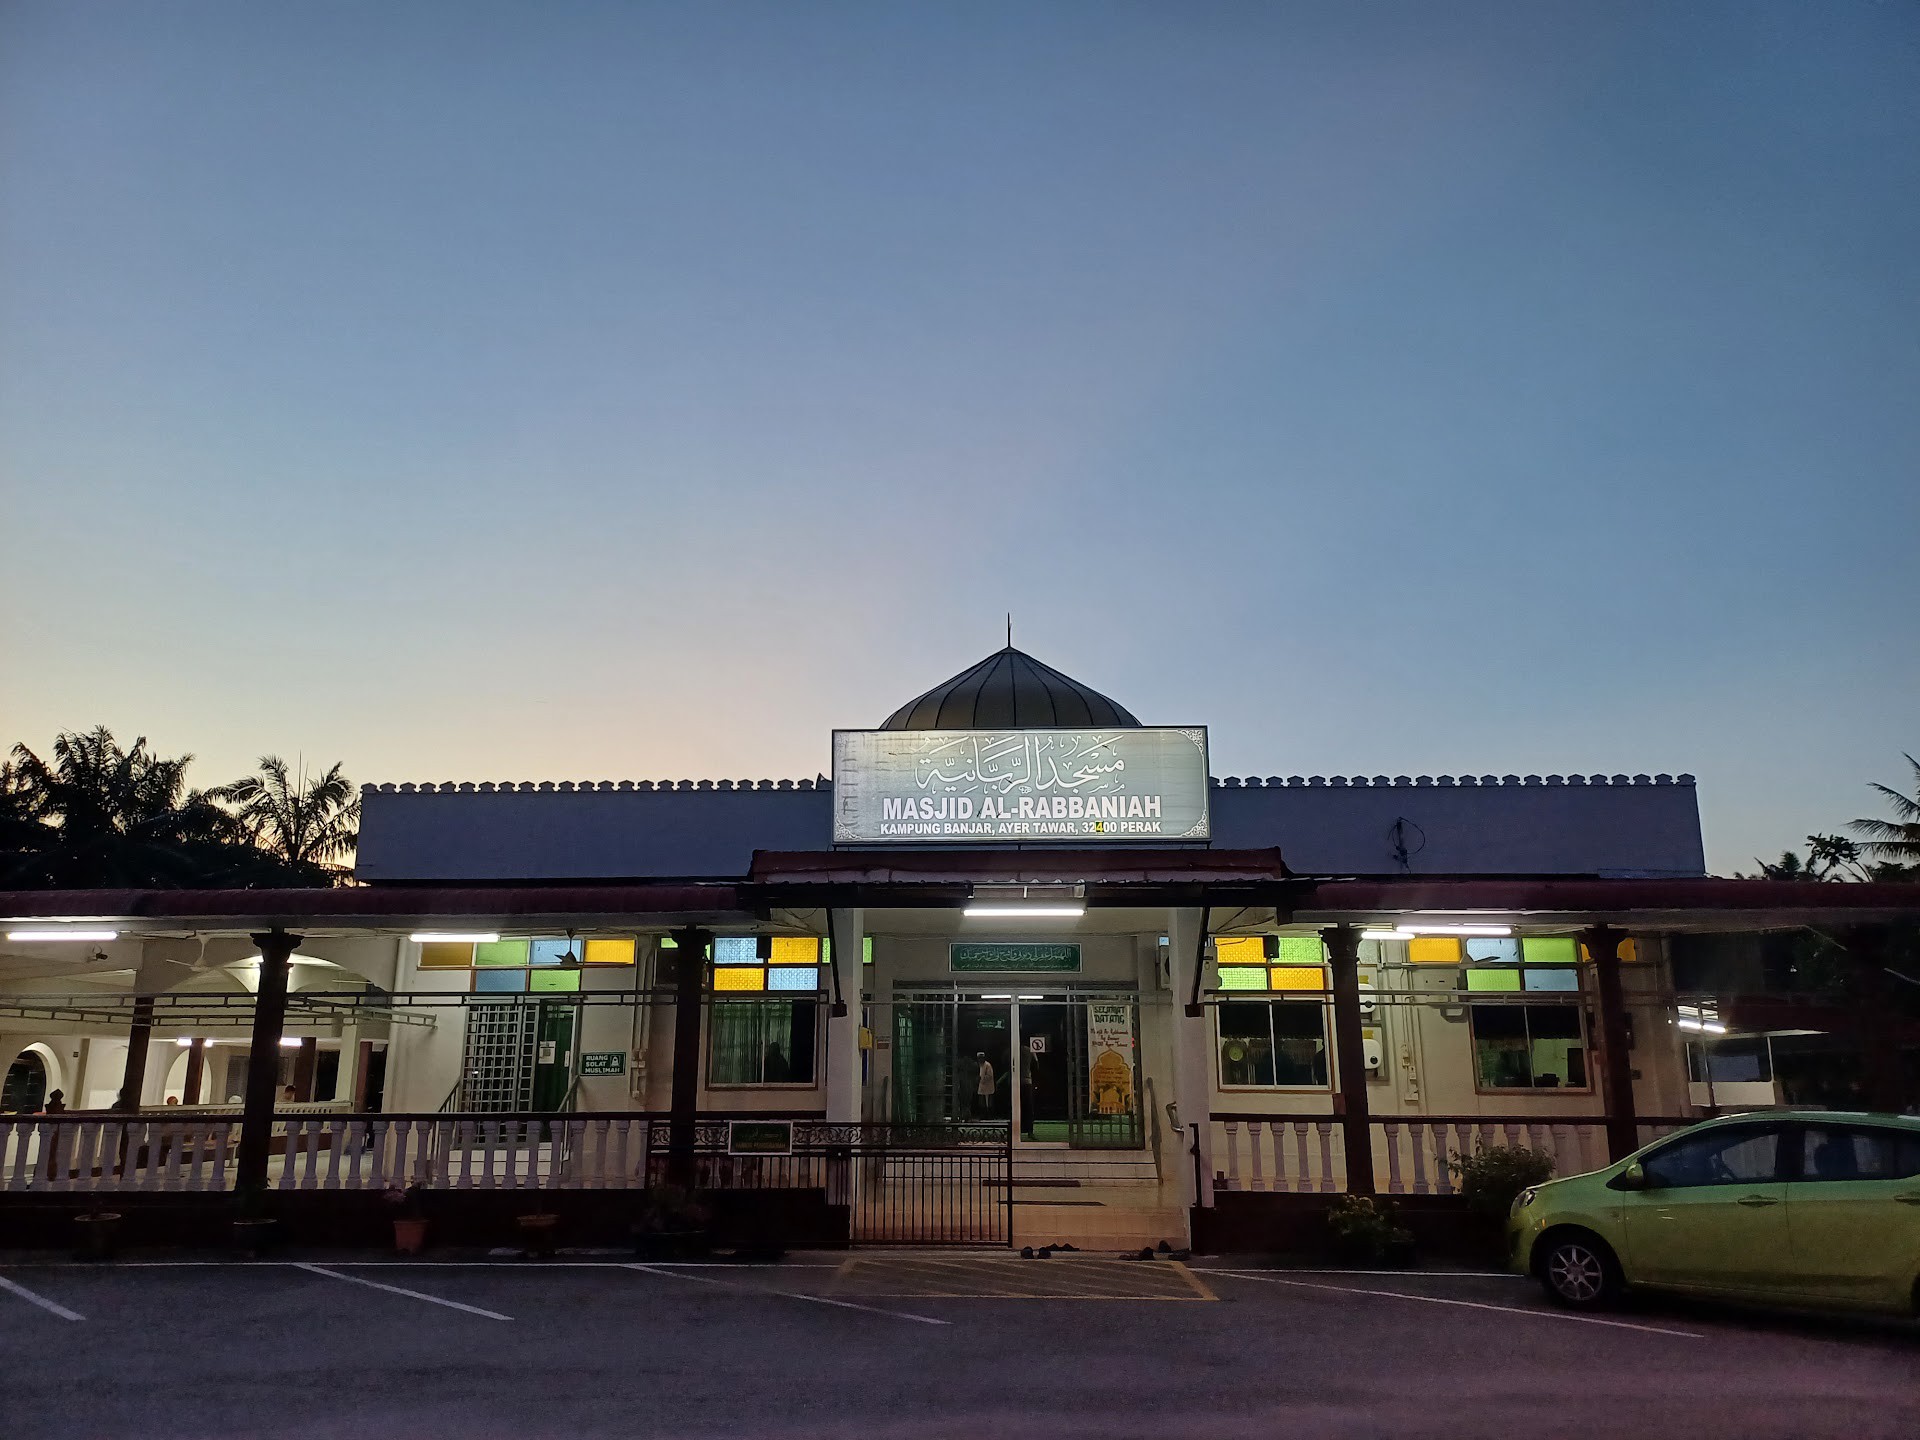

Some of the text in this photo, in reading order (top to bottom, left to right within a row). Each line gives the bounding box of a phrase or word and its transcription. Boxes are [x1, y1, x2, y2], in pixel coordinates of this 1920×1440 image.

[883, 795, 1161, 820] MASJID AL-RABBANIAH
[880, 821, 1161, 836] KAMPUNG BANJAR, AYER TAWAR, 32400 PERAK
